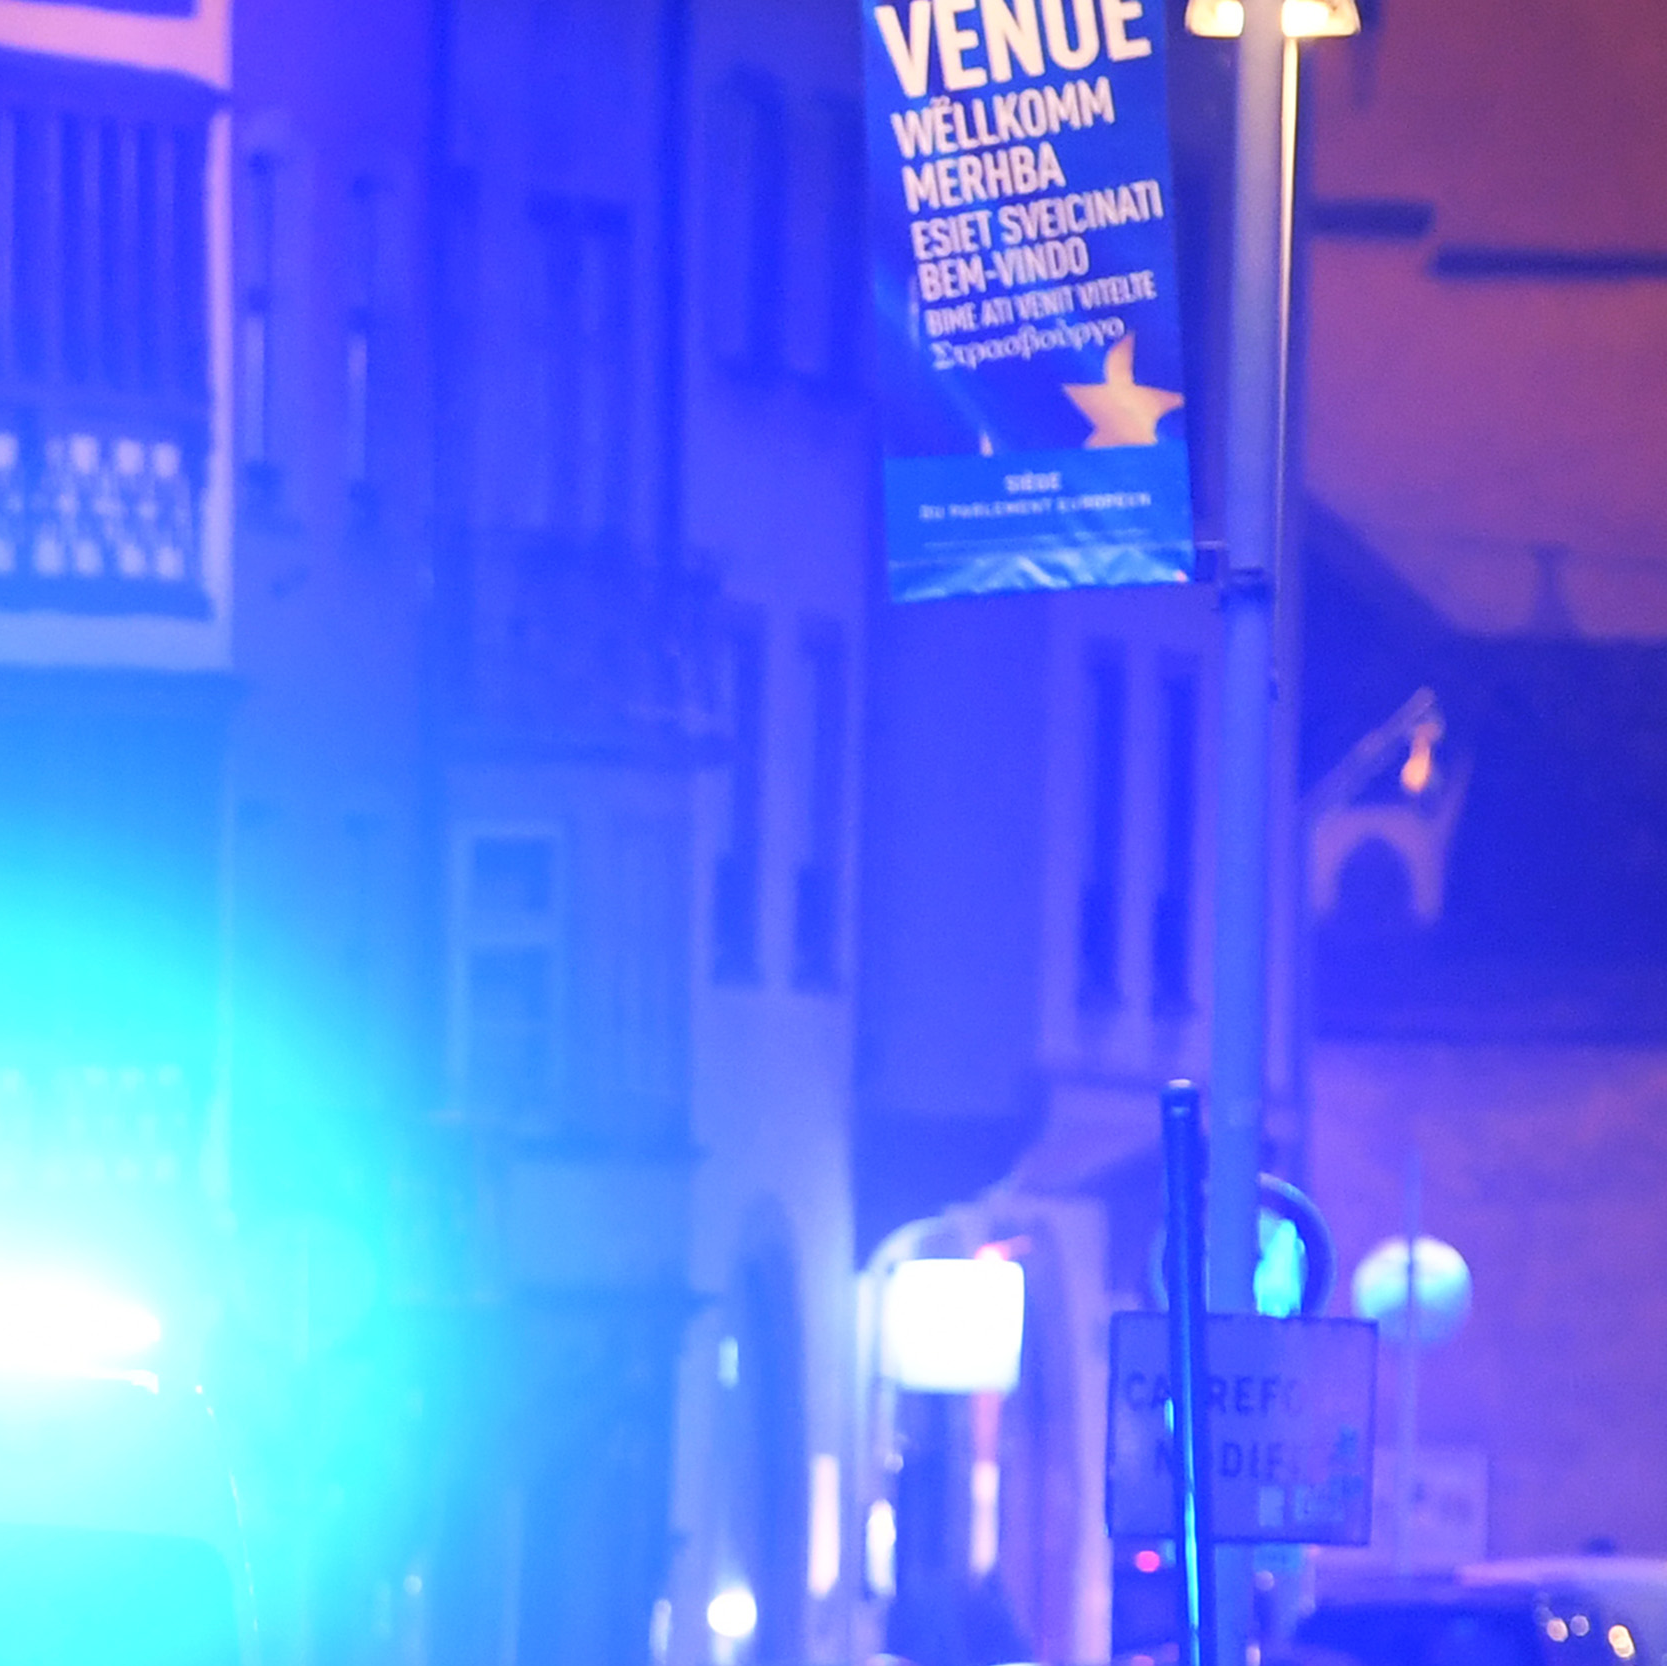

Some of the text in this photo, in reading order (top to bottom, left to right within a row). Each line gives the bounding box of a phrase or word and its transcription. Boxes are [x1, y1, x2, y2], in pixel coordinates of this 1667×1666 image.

[874, 0, 1152, 98] VENUE
[890, 76, 1115, 159] WËLLKOMM
[902, 141, 1066, 214] MERHBA
[910, 209, 993, 261] ESIET
[918, 236, 1089, 302] BEM-VINDO
